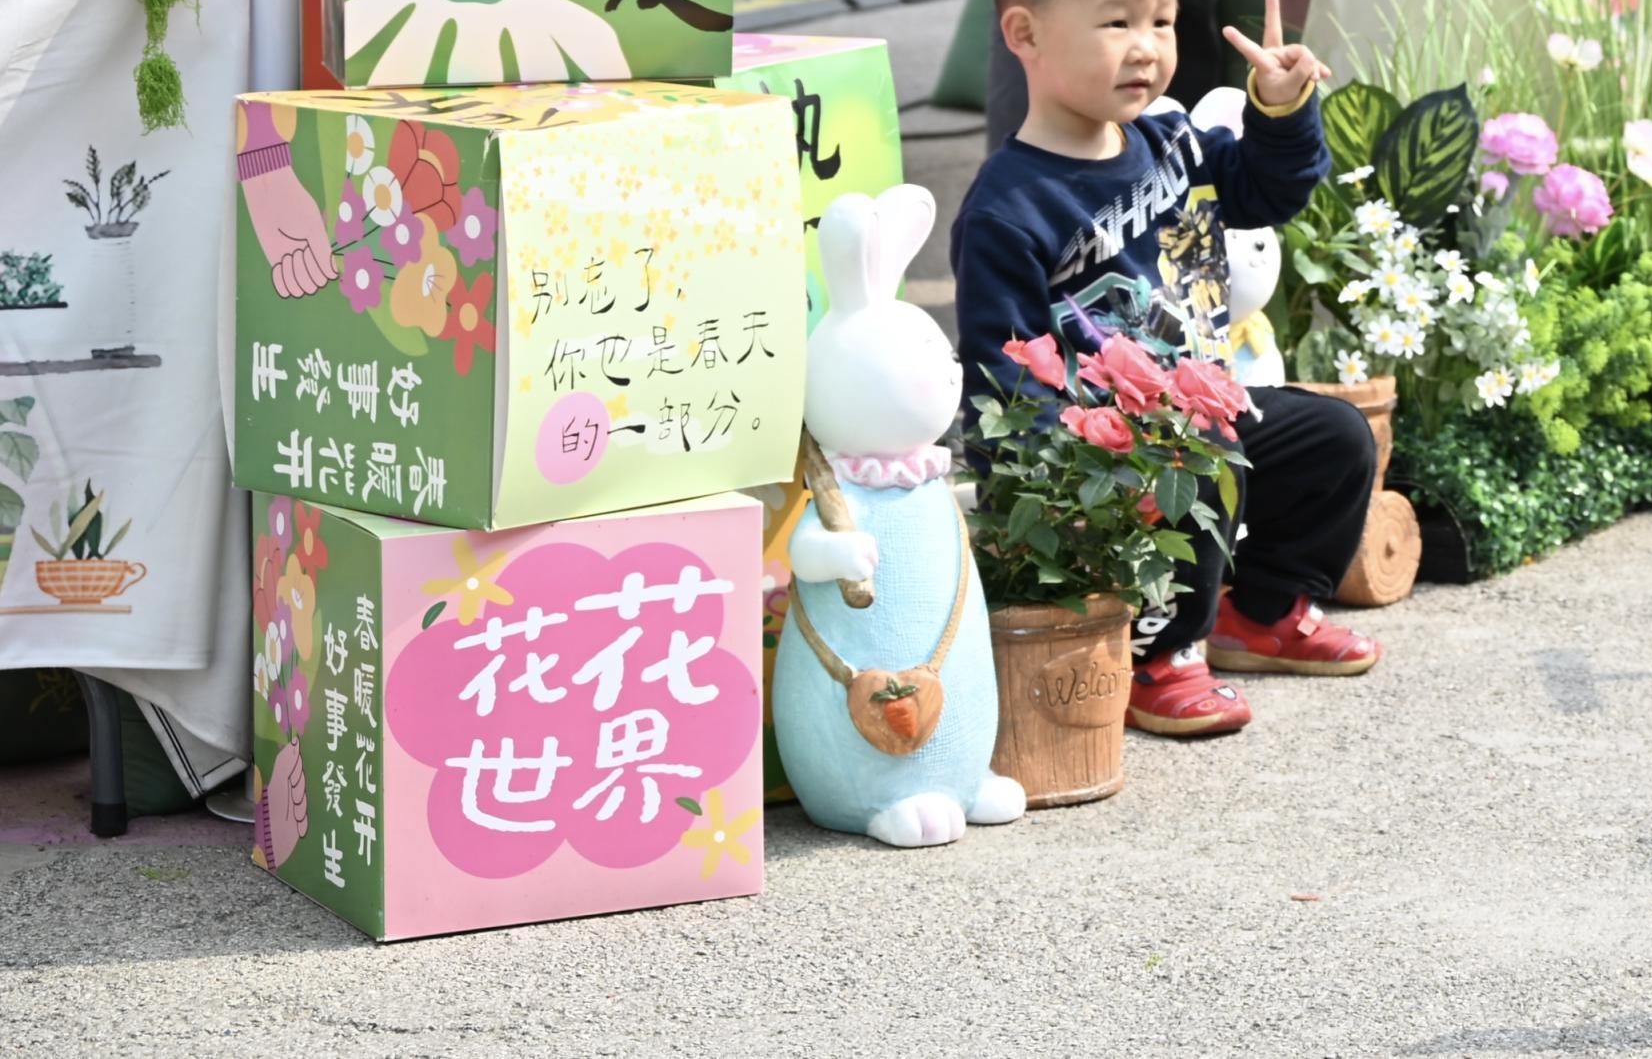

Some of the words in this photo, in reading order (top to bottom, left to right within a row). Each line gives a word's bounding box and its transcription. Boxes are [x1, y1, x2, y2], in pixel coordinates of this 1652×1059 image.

[544, 311, 775, 392] 你也是春天
[562, 390, 762, 461] 的一部分。
[276, 429, 446, 515] 春暖花开
[322, 622, 349, 889] 好事發生
[352, 593, 378, 866] 春暖花开
